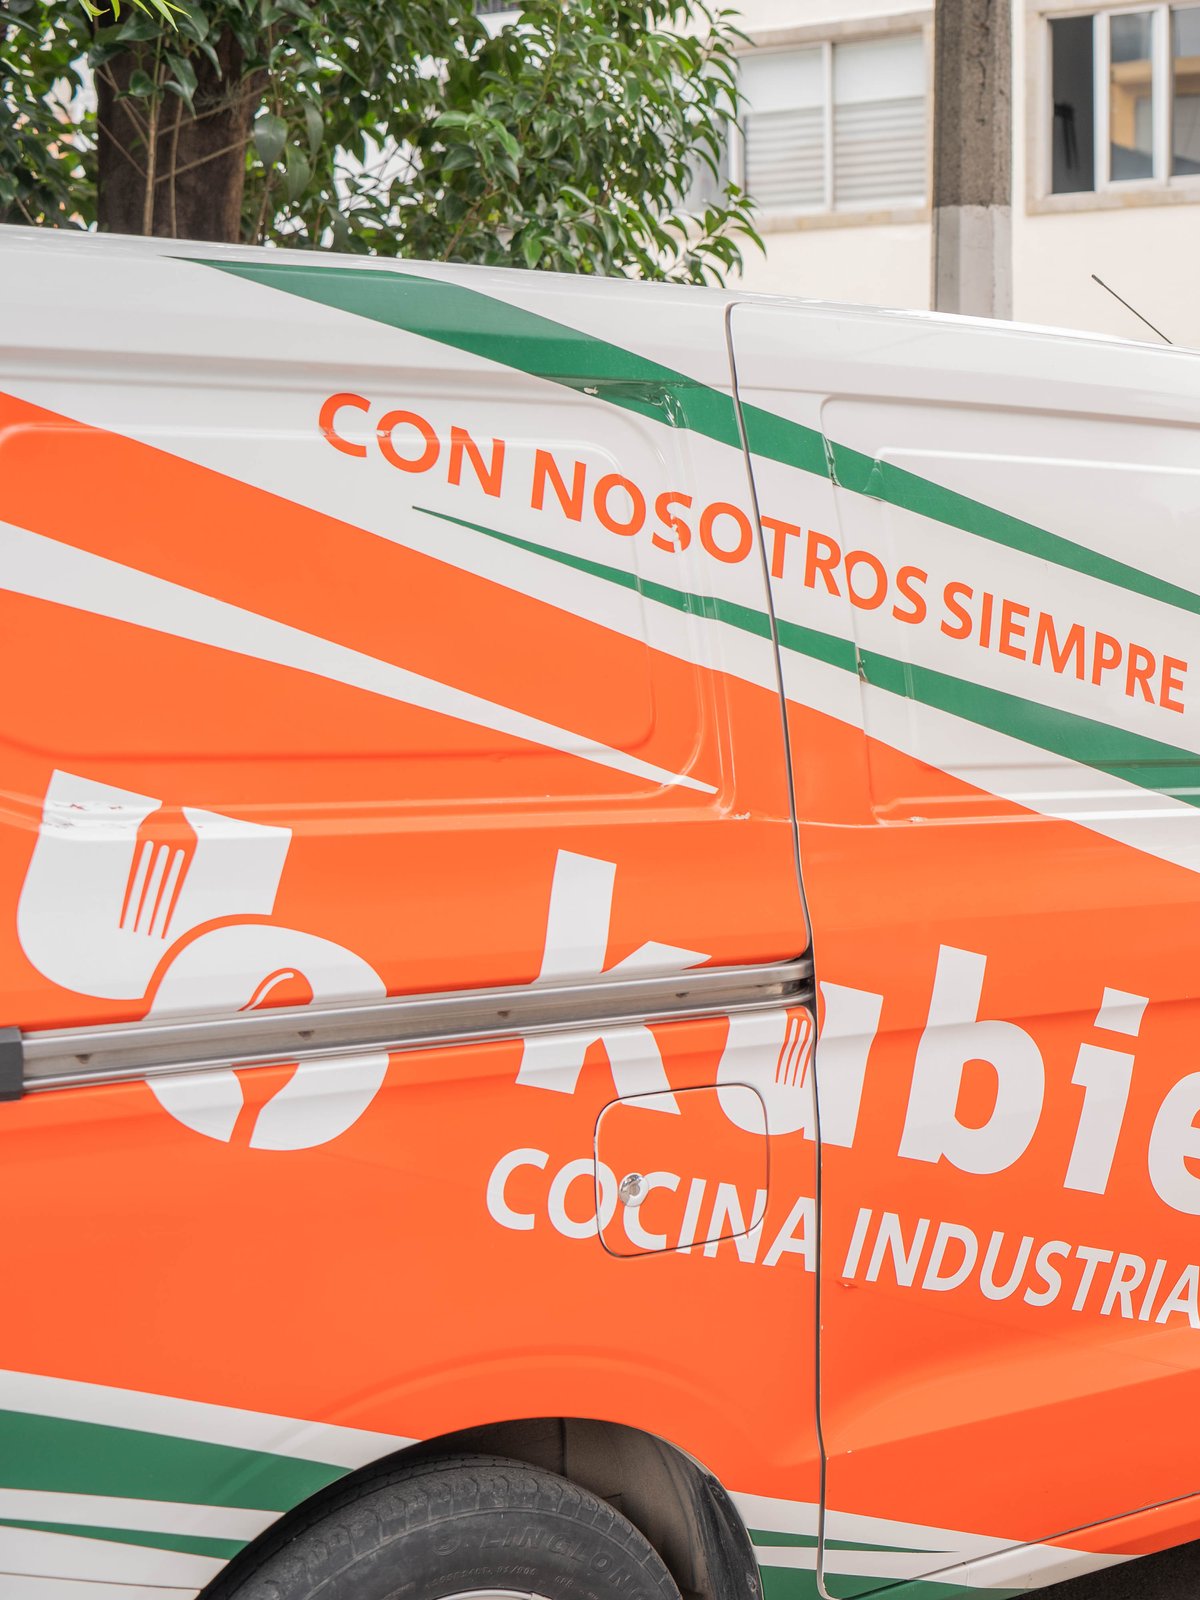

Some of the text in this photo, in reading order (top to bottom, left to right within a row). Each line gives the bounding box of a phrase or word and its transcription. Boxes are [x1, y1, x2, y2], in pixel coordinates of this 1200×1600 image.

[318, 392, 505, 498] CON
[530, 449, 928, 625] NOSOTROS
[940, 581, 1188, 714] SIEMPRE
[486, 1148, 817, 1273] COCINA
